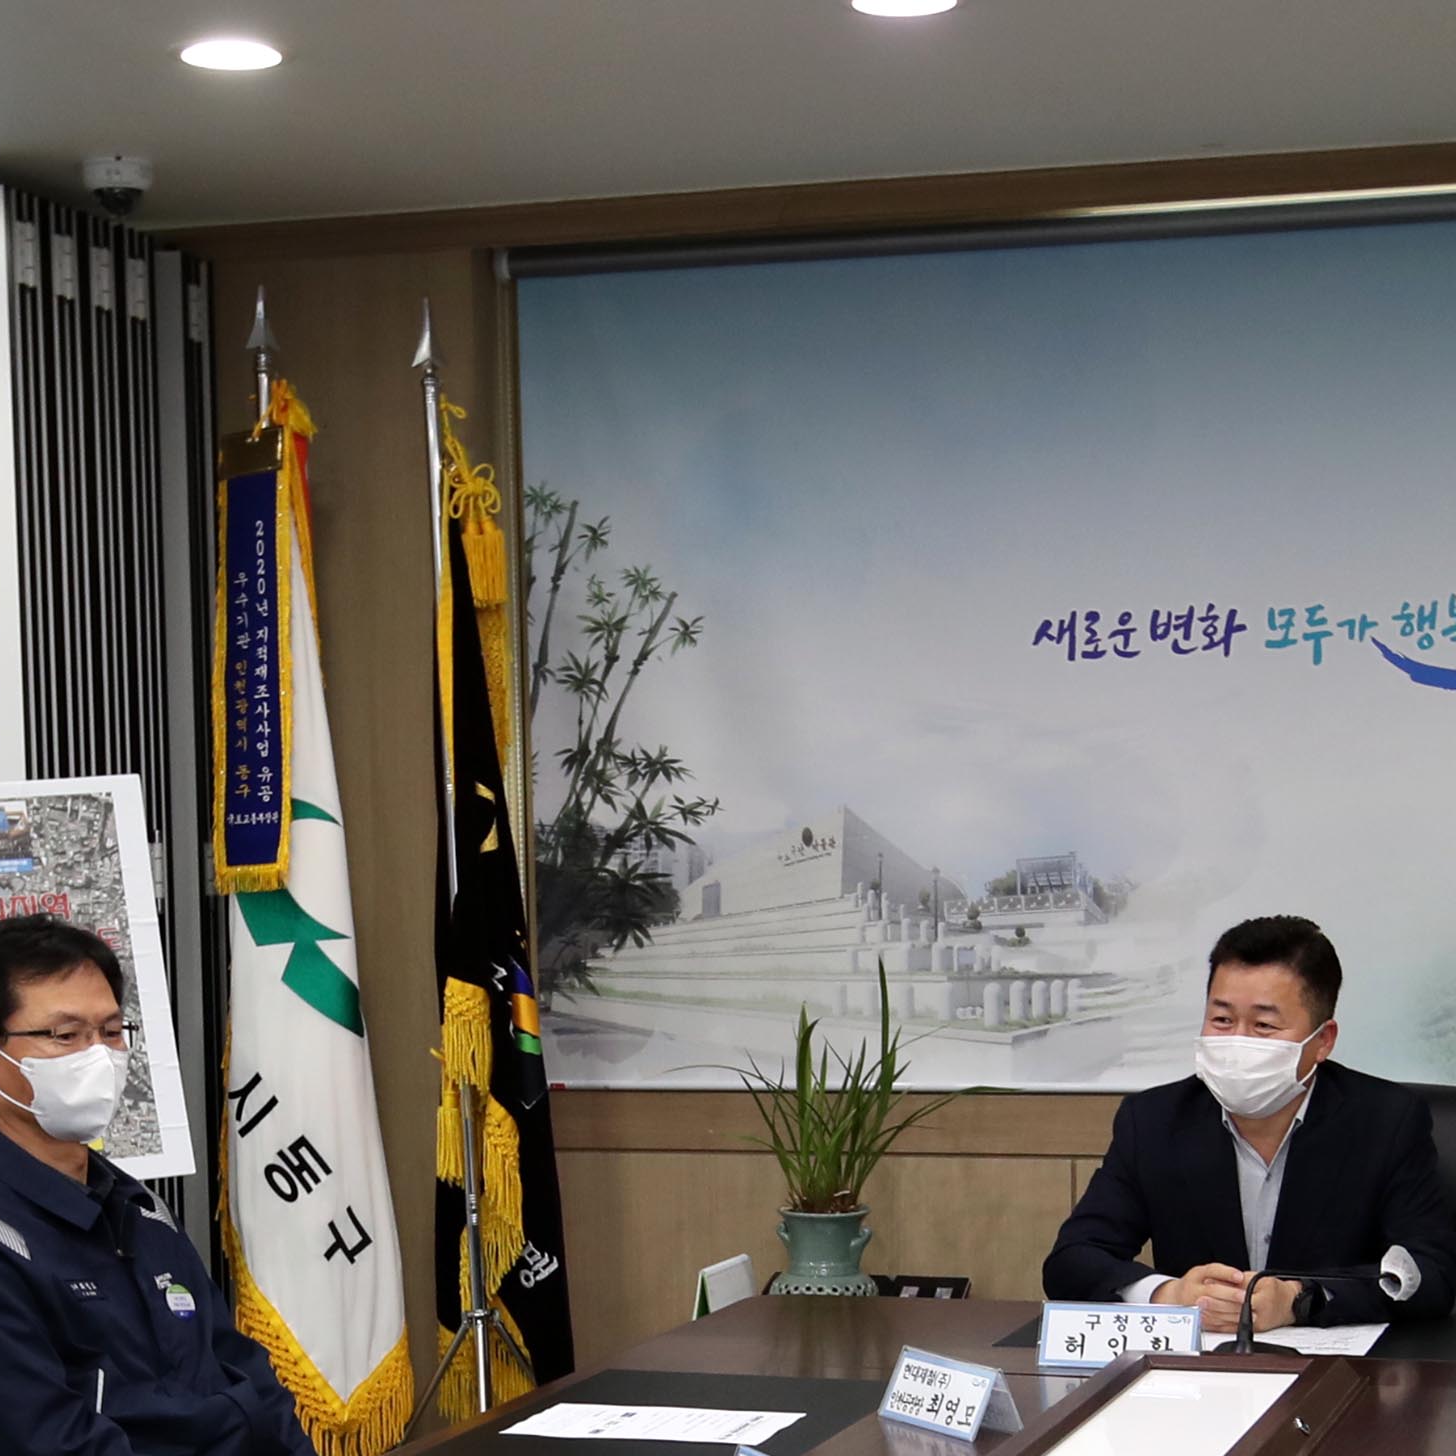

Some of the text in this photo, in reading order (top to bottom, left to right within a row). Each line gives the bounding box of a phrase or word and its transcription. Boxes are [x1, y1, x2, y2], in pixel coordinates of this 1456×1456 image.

[253, 519, 273, 803] 2020년 지적재조사사업 유공
[1032, 607, 1140, 662] 새로운
[1150, 603, 1248, 657] 변화
[1264, 604, 1375, 665] 모두가
[233, 571, 252, 799] 우수기관 인천광역시 동구
[1085, 1314, 1158, 1333] 구청장
[926, 1392, 976, 1427] 최영모
